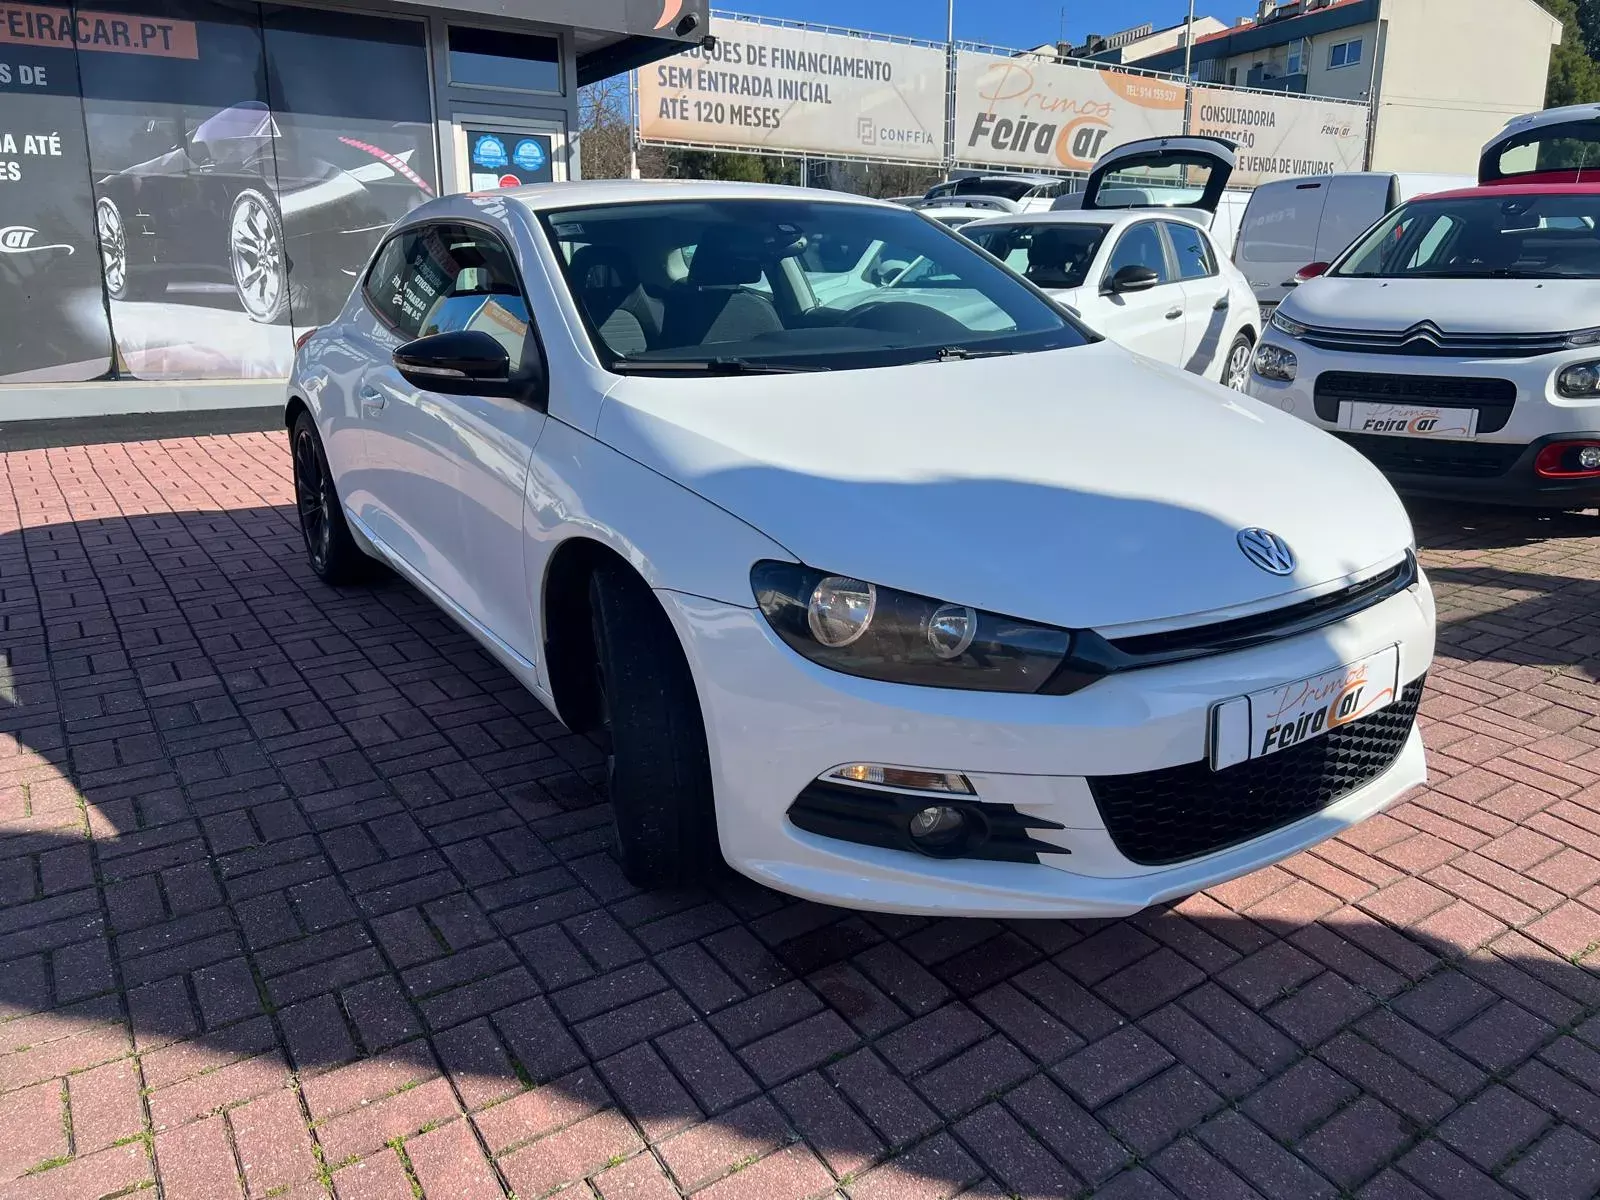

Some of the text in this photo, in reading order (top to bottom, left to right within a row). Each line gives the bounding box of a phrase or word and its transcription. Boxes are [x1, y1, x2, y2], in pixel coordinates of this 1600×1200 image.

[18, 65, 48, 86] DE
[746, 44, 767, 67] DE
[771, 47, 892, 82] FINANCIAMENTO
[657, 65, 832, 104] SEM ENTRADA INICIAL
[979, 62, 1116, 120] Primos
[659, 94, 780, 129] ATÉ 120 MESES
[1200, 104, 1276, 128] CONSULTADORIA
[24, 131, 62, 156] ATÉ
[880, 127, 934, 145] CONFFIA
[1239, 156, 1245, 171] E
[1247, 156, 1277, 174] VENDA
[1279, 158, 1291, 174] DE
[1292, 159, 1334, 176] VIATURAS
[1267, 663, 1368, 731] Primos
